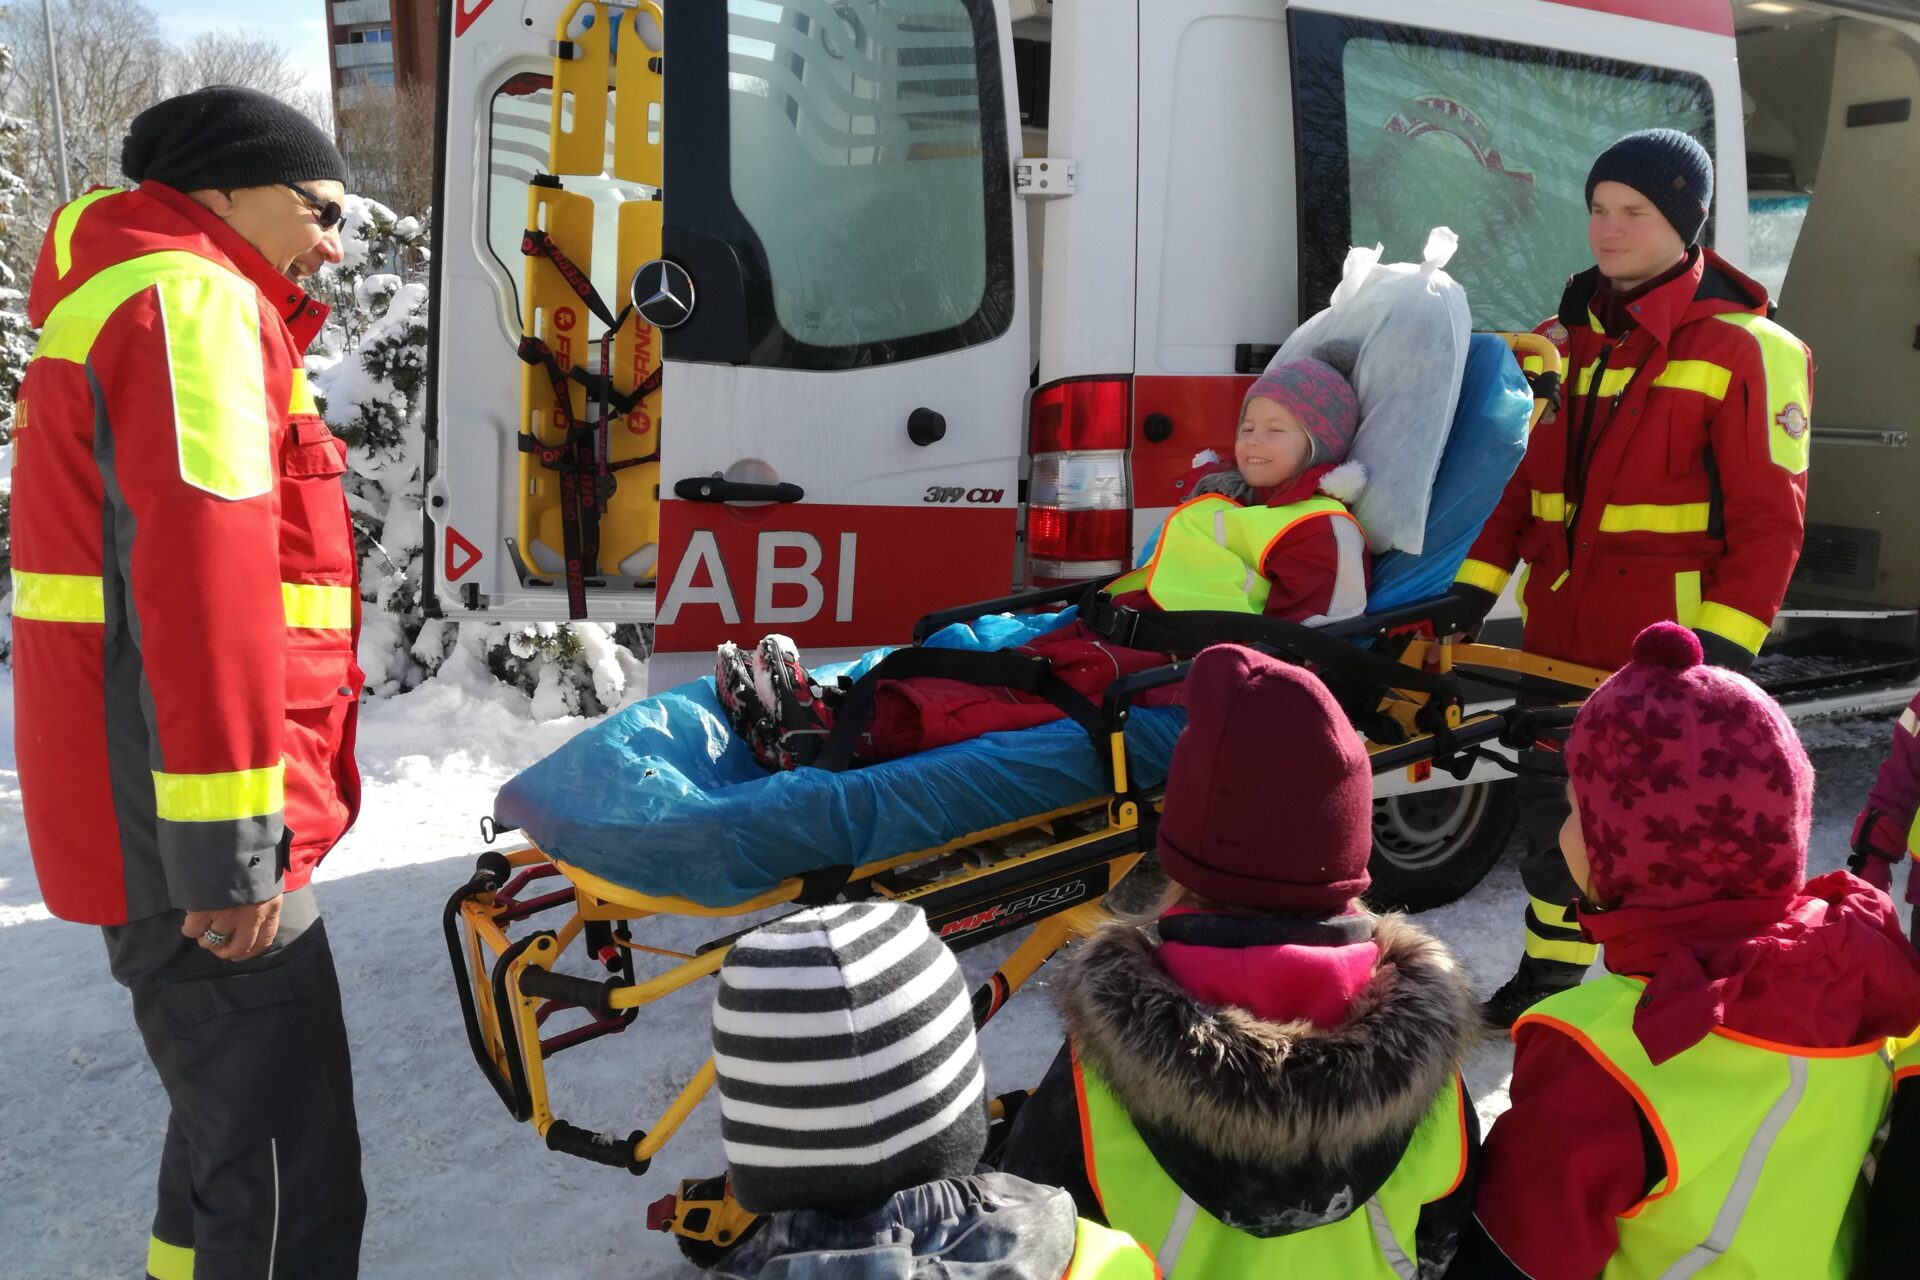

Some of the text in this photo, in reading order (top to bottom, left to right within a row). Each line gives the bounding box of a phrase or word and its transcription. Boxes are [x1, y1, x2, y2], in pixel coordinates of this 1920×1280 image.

[553, 334, 571, 430] FEO
[923, 486, 1005, 503] 319 CDI
[655, 530, 856, 624] ABI
